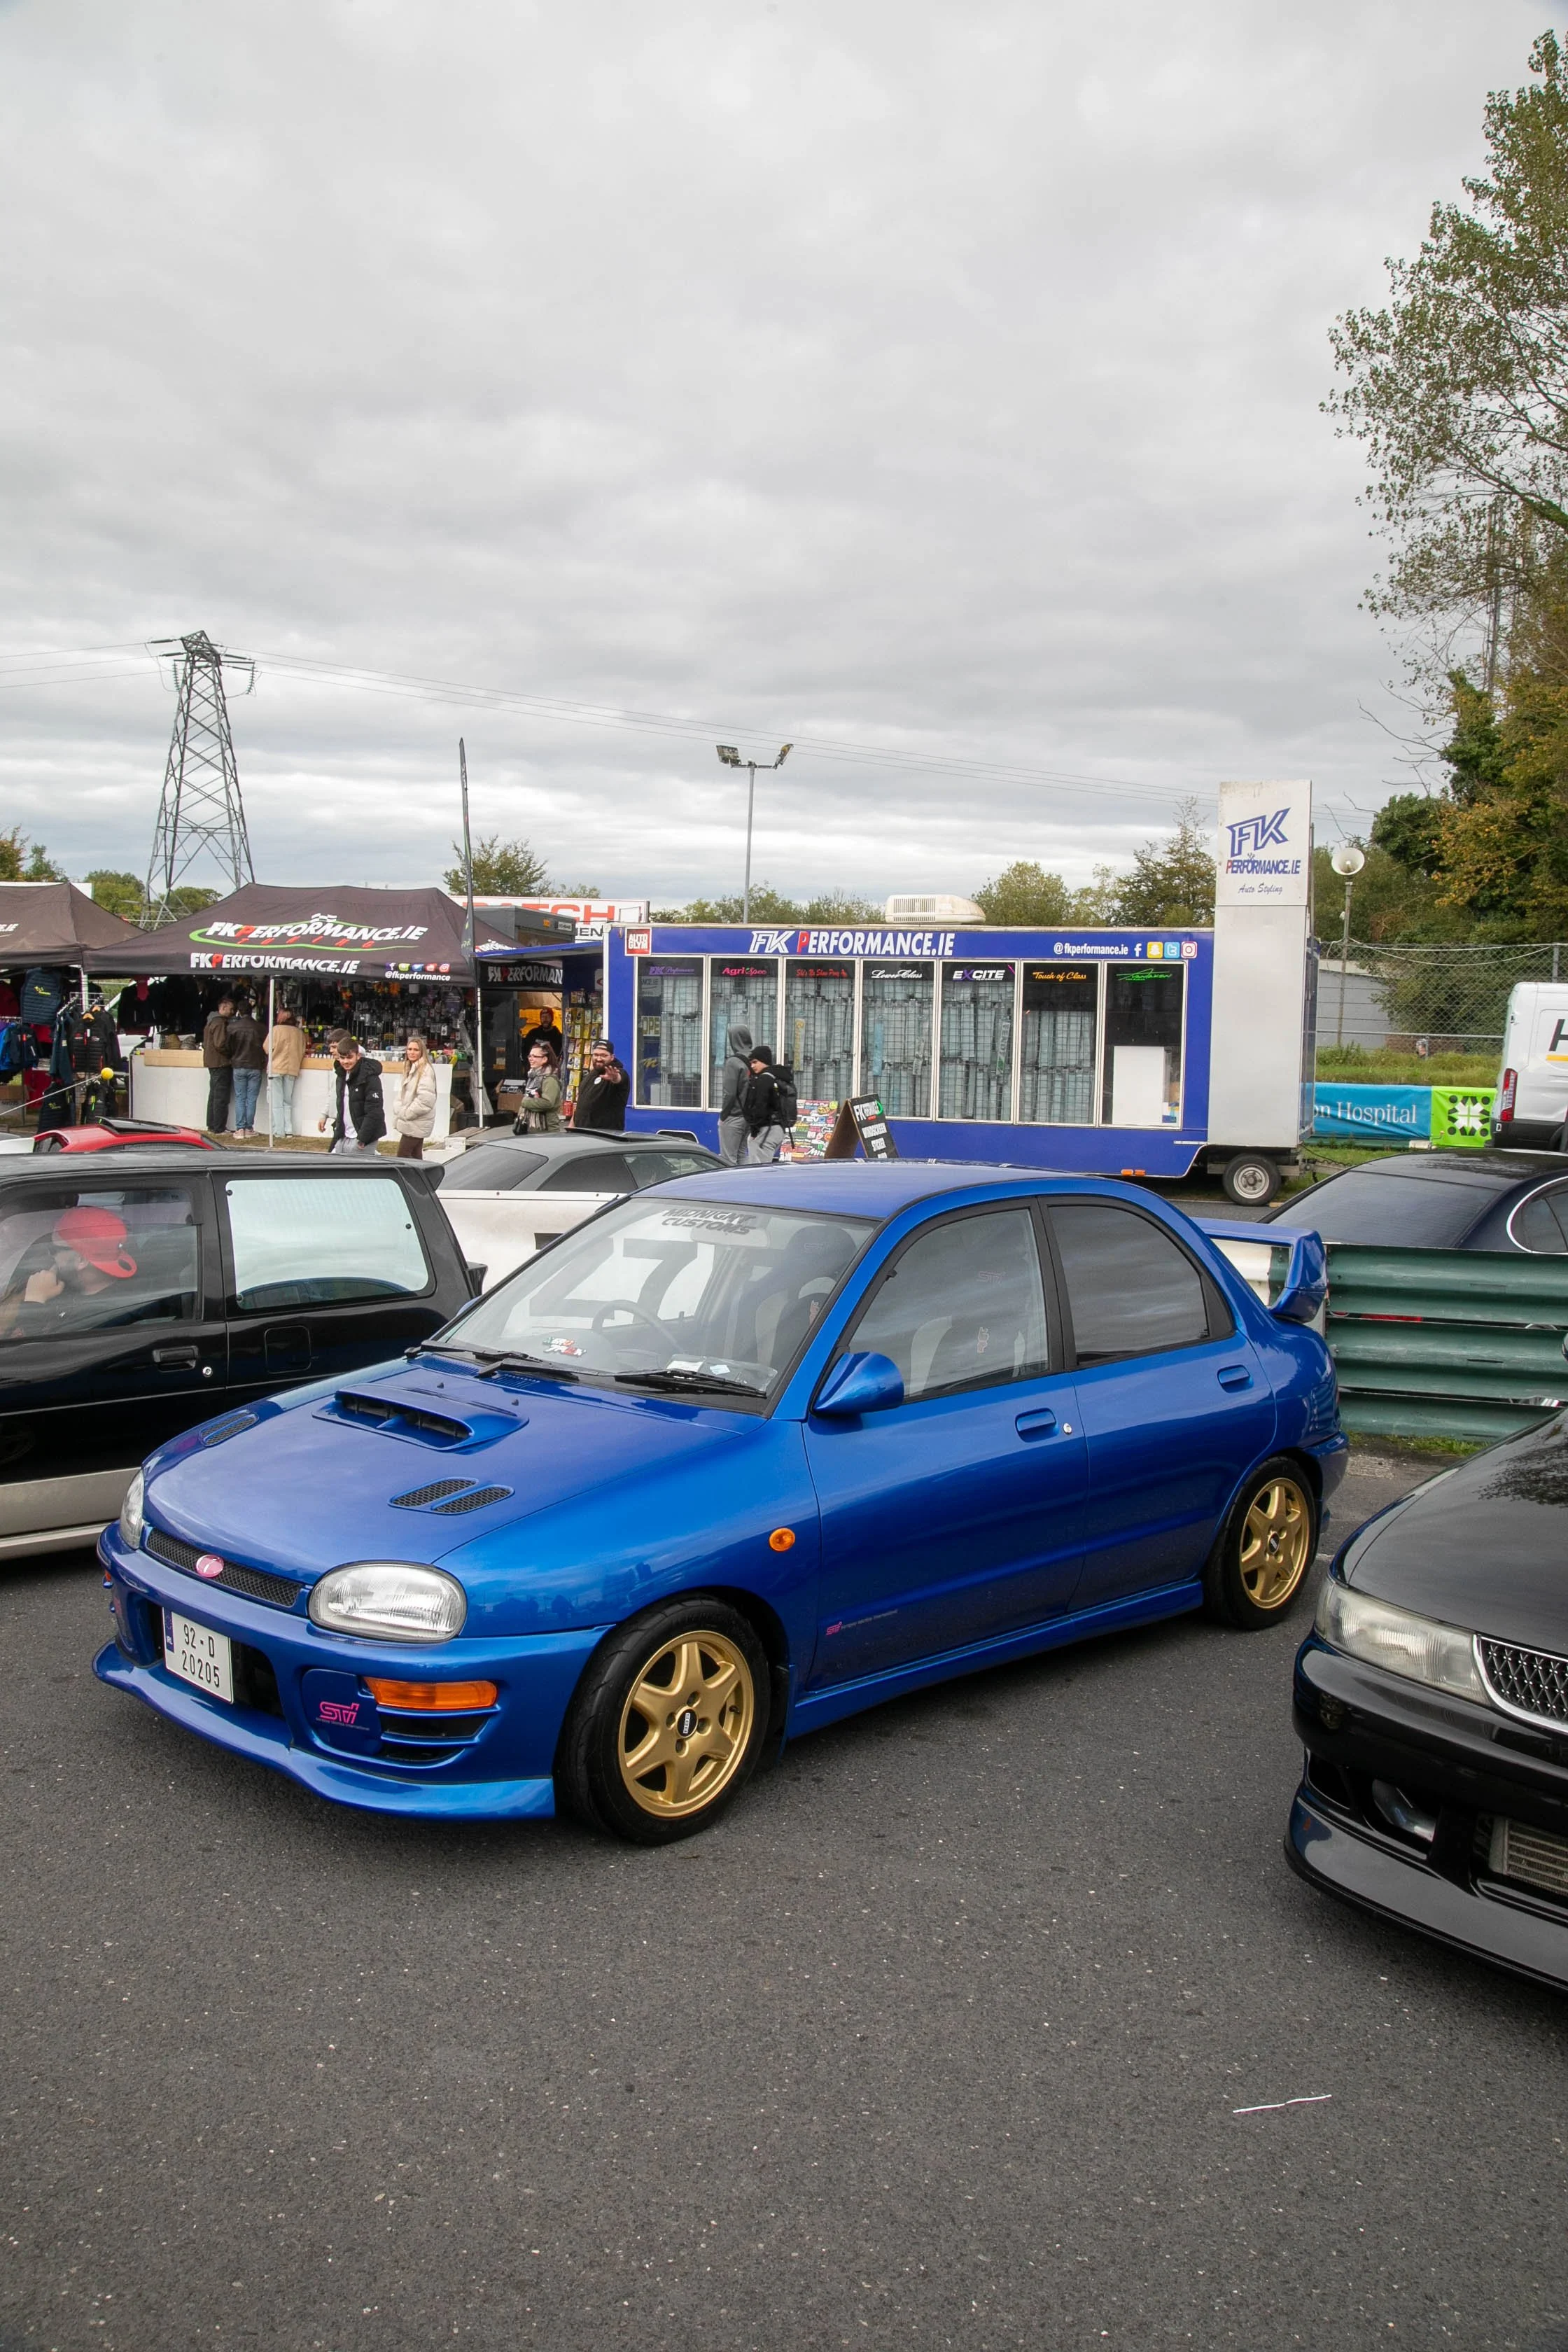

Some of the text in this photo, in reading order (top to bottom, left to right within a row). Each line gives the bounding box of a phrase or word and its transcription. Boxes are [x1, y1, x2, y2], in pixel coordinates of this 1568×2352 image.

[1226, 807, 1291, 858] FK
[1226, 860, 1301, 874] PERFORMANCE.IE
[1238, 883, 1282, 895] Auto Styling
[749, 930, 955, 955] FK PERFORMANCE.IE
[190, 952, 360, 974] FKPERFORMANCE.IE
[385, 972, 450, 981] @fkperformance
[953, 969, 1004, 980] EXCITE
[1056, 972, 1065, 981] of
[1337, 1102, 1417, 1124] Hospital
[662, 1218, 757, 1235] CUSTOMS
[182, 1649, 220, 1688] 20205
